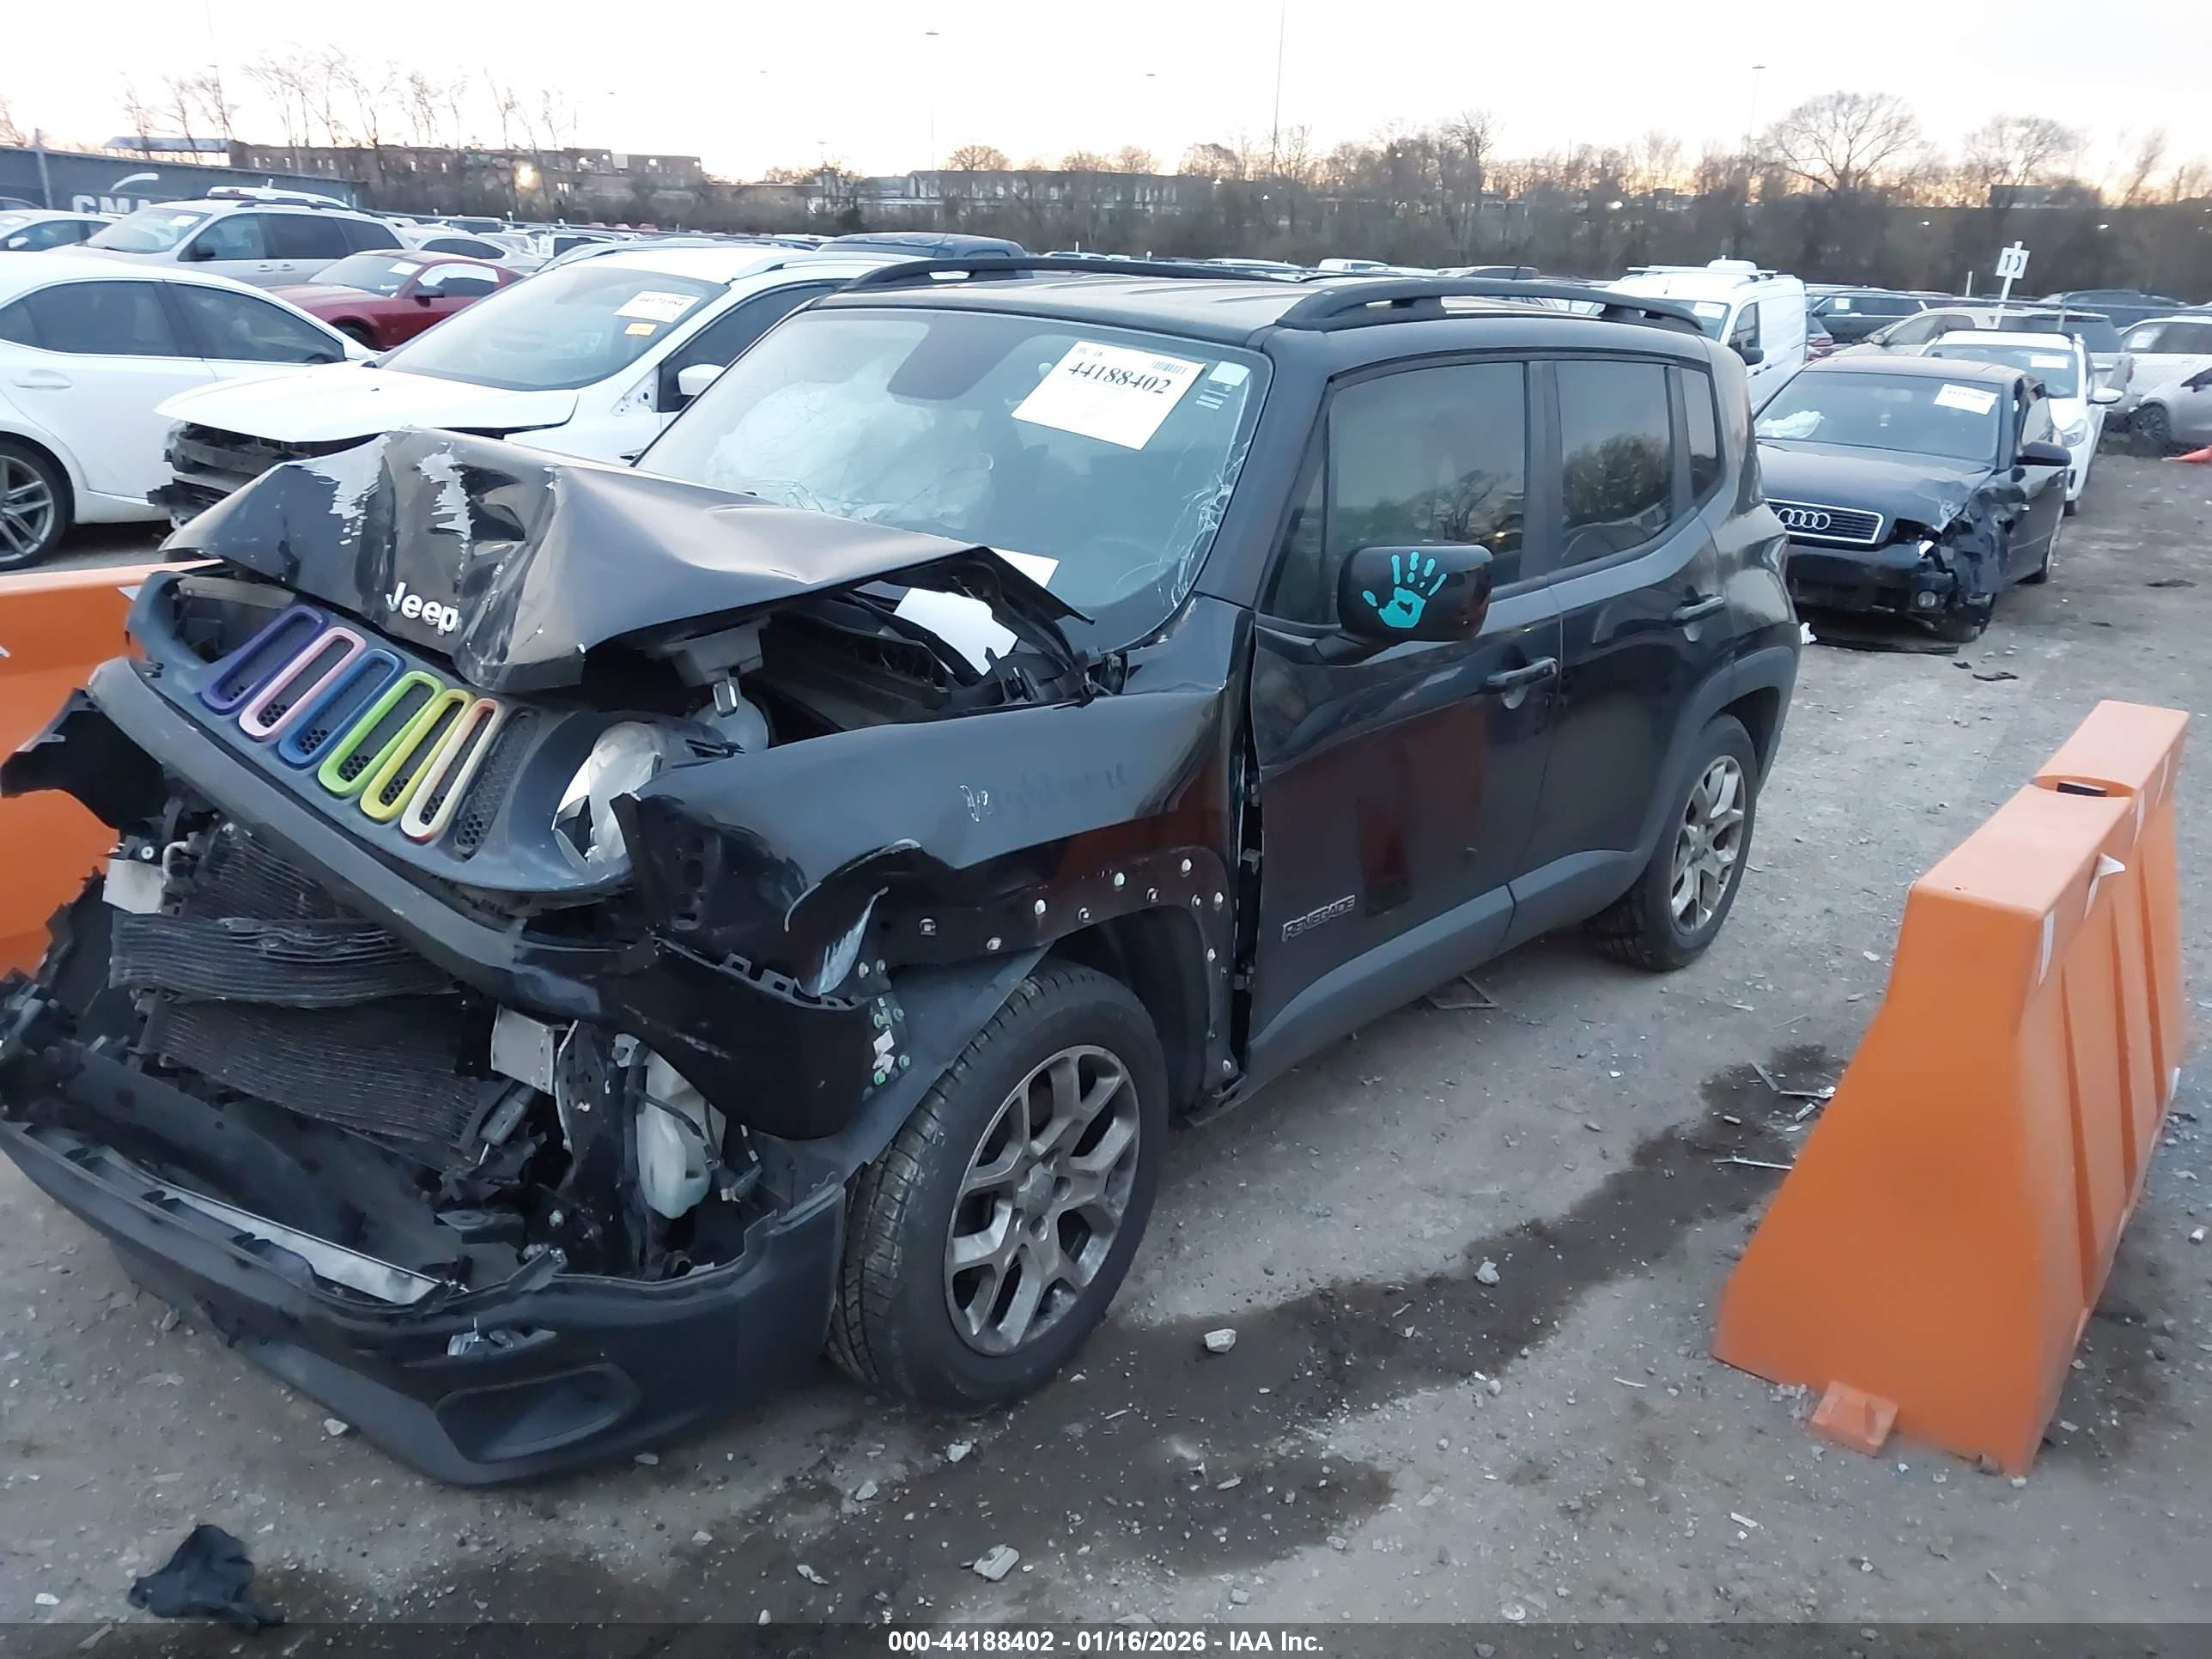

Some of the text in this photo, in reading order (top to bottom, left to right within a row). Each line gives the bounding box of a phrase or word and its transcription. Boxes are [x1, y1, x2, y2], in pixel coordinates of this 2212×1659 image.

[1068, 361, 1172, 395] 44188402
[385, 581, 459, 636] Jeep
[1281, 894, 1356, 942] RENEGADE
